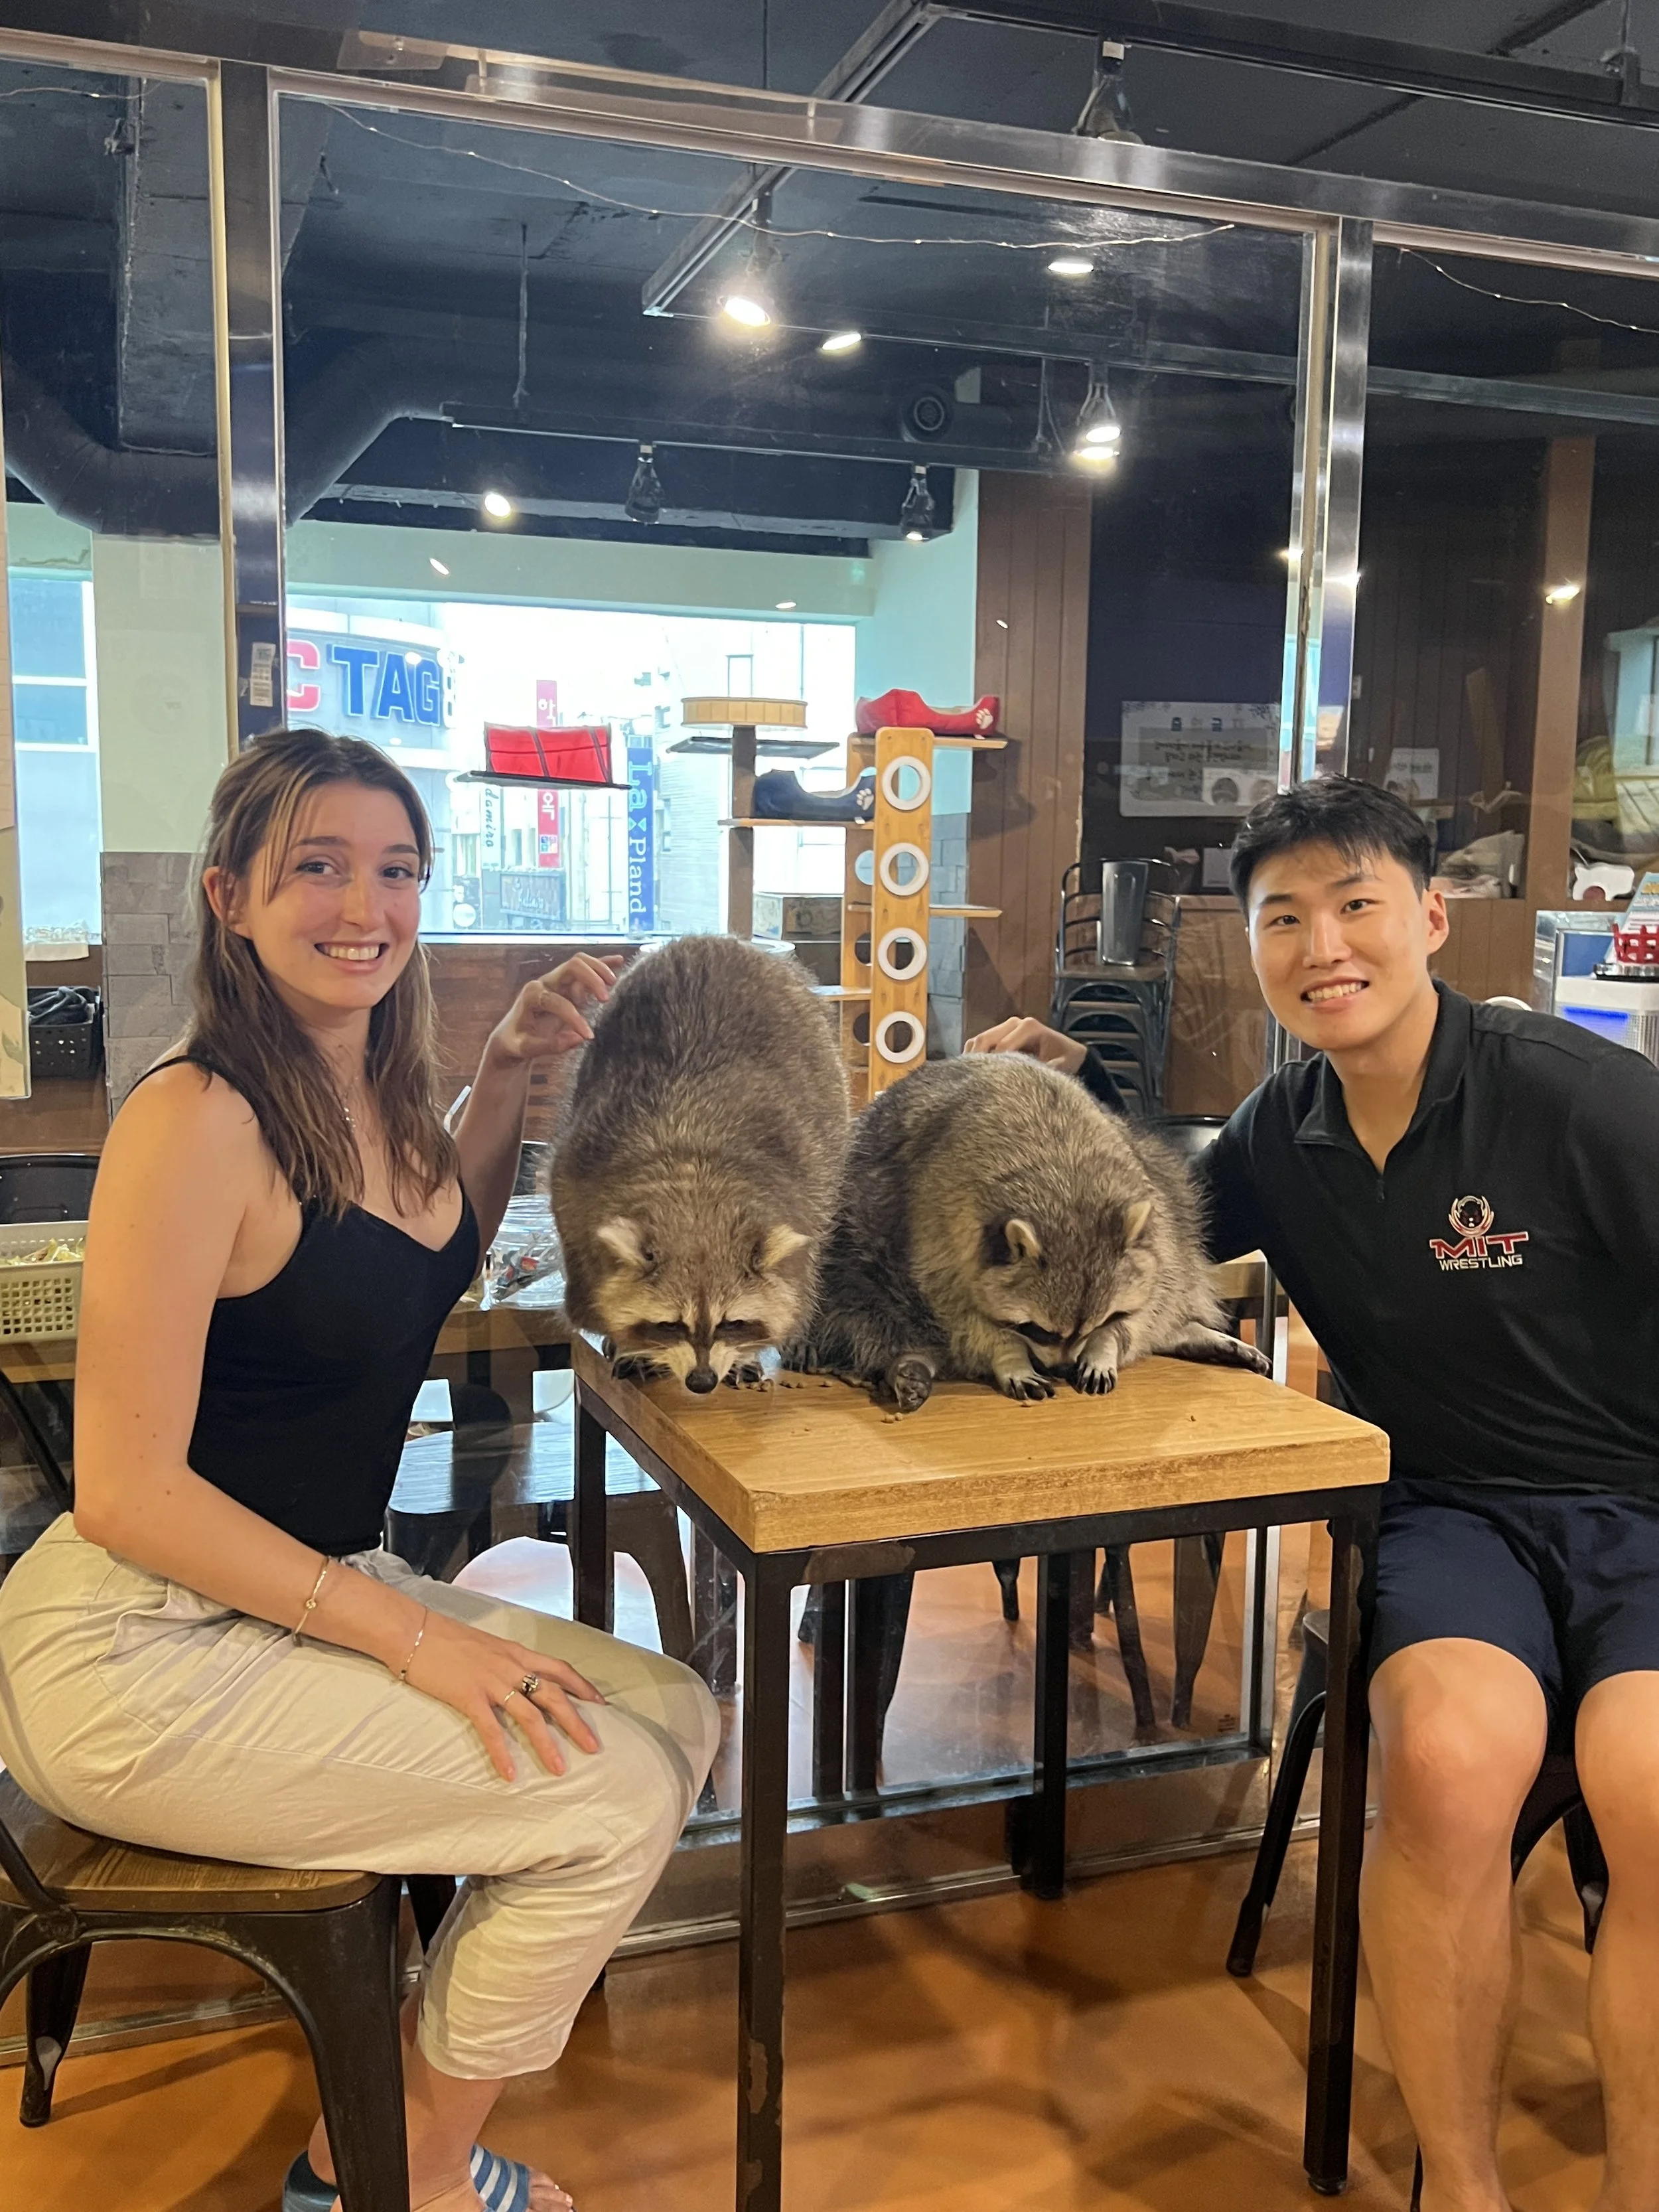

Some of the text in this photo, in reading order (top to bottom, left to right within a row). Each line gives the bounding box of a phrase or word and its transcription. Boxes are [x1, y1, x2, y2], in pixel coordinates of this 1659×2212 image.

[330, 644, 457, 729] TAG
[1429, 1231, 1530, 1260] MIT
[1439, 1254, 1524, 1272] WRESTLING
